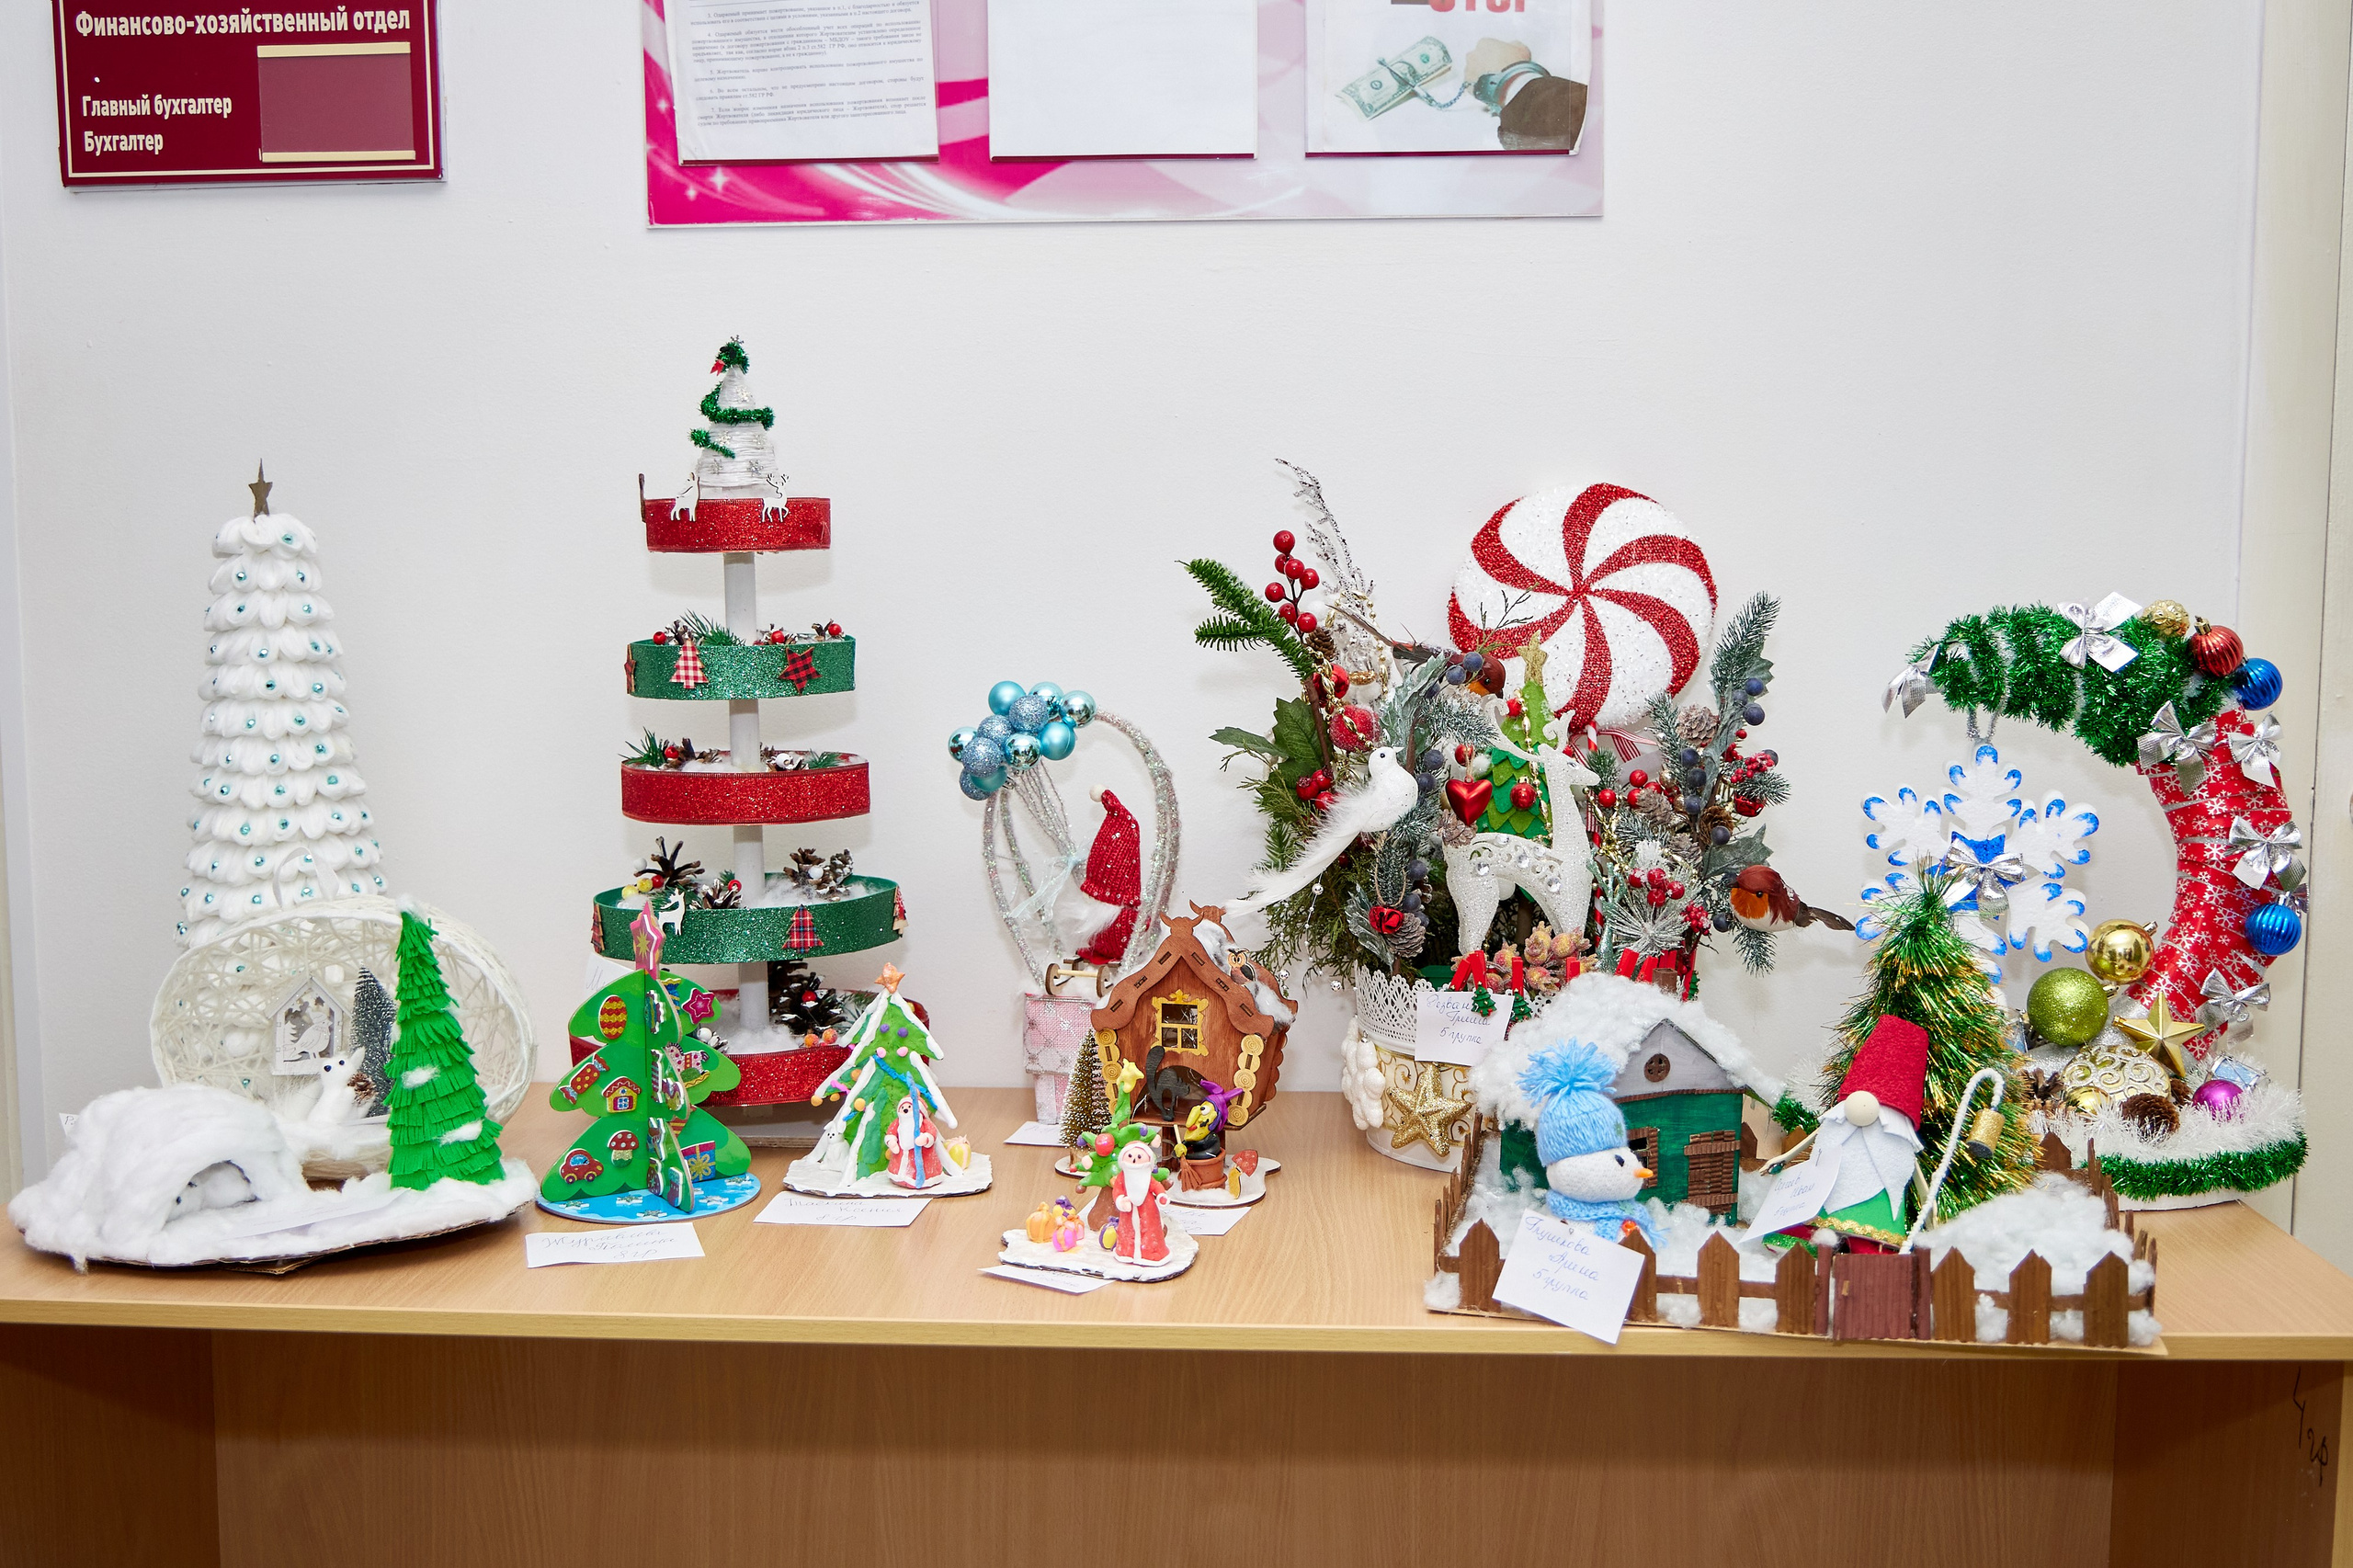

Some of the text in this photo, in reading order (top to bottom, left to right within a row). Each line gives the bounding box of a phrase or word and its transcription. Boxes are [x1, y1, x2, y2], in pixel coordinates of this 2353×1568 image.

[75, 6, 411, 38] Финансово-хозяйственный отдел
[82, 94, 233, 120] Главный бухгалтер
[84, 131, 164, 156] Бухгалтер
[1439, 1027, 1449, 1037] 5
[1532, 1268, 1589, 1301] 5 группа
